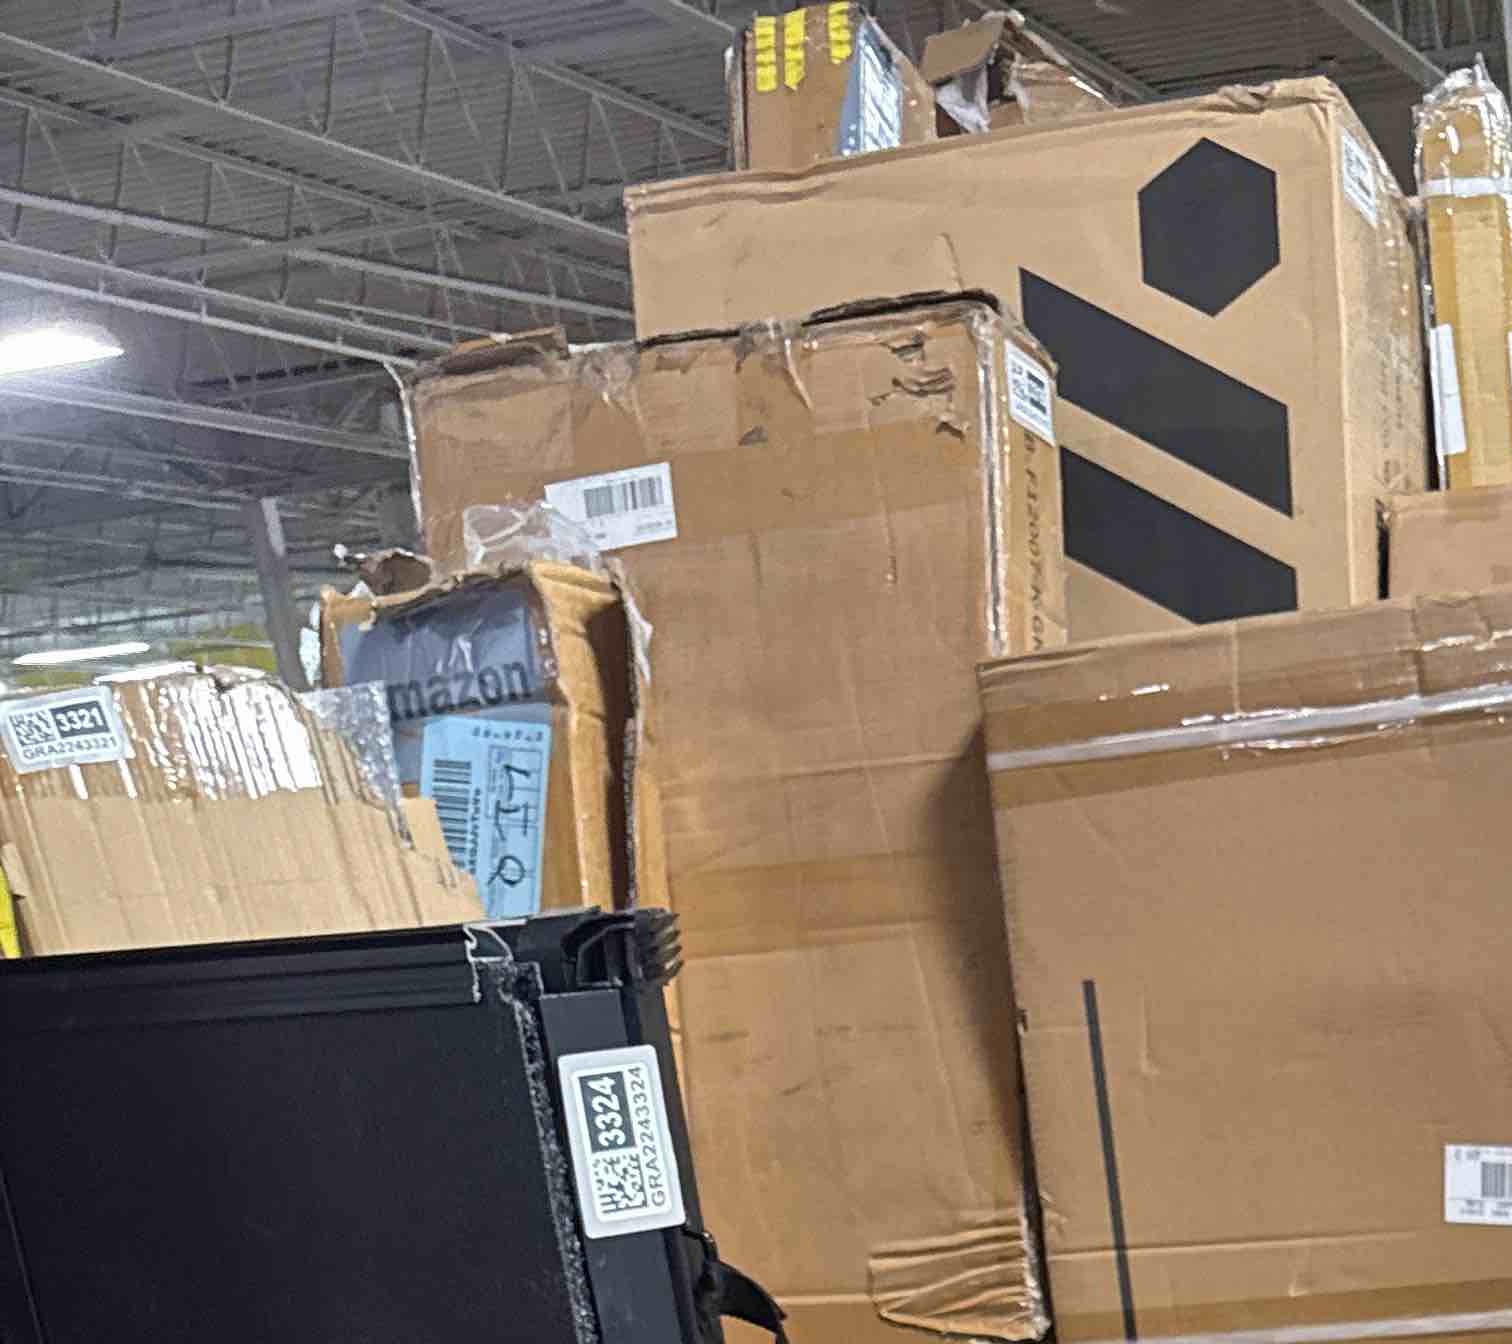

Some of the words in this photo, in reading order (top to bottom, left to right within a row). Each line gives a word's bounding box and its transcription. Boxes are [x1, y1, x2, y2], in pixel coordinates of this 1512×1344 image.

[55, 706, 104, 733] 3321
[388, 659, 533, 721] mazon
[22, 735, 119, 760] GRA2243321
[587, 1075, 627, 1147] 3324
[627, 1066, 667, 1208] GRA2243324
